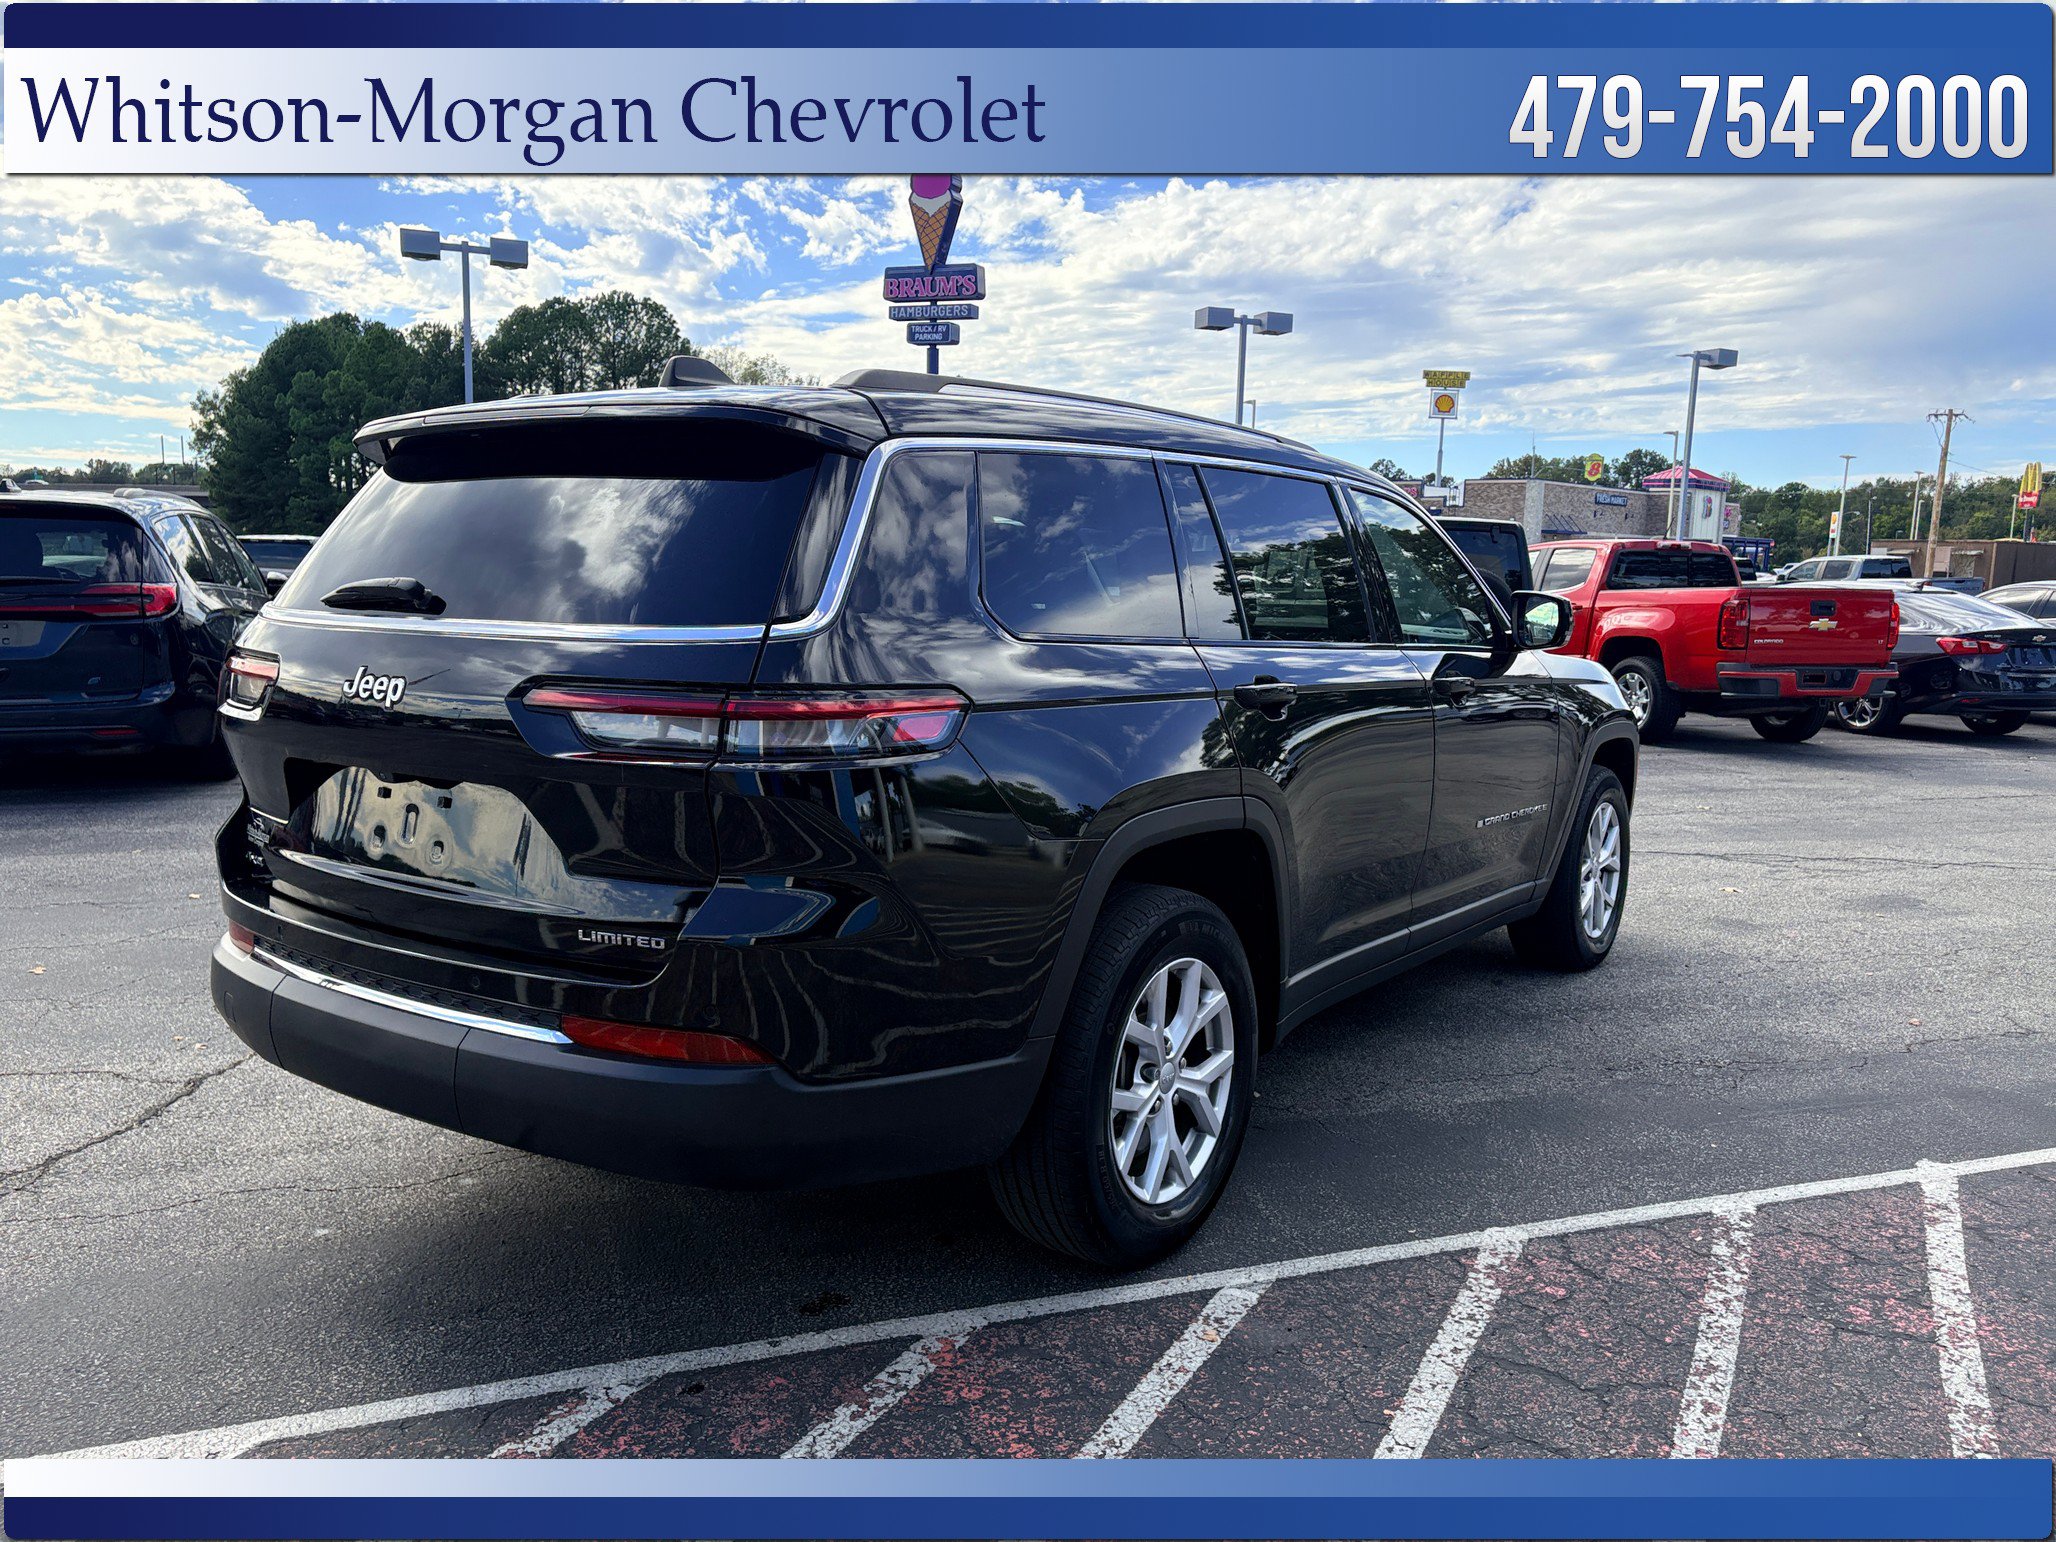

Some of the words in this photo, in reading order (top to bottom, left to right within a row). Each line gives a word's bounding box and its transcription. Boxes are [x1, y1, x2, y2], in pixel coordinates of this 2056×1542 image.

[884, 275, 976, 298] BRAUM'S
[891, 305, 969, 318] HAMBURGERS
[914, 333, 943, 341] PARKING
[1423, 371, 1470, 380] WAFFLE
[1588, 462, 1602, 477] 8
[343, 666, 405, 708] Jeep
[1484, 812, 1511, 826] GRAND
[1511, 804, 1548, 818] CHEROKEE
[577, 929, 666, 950] LIMITED
